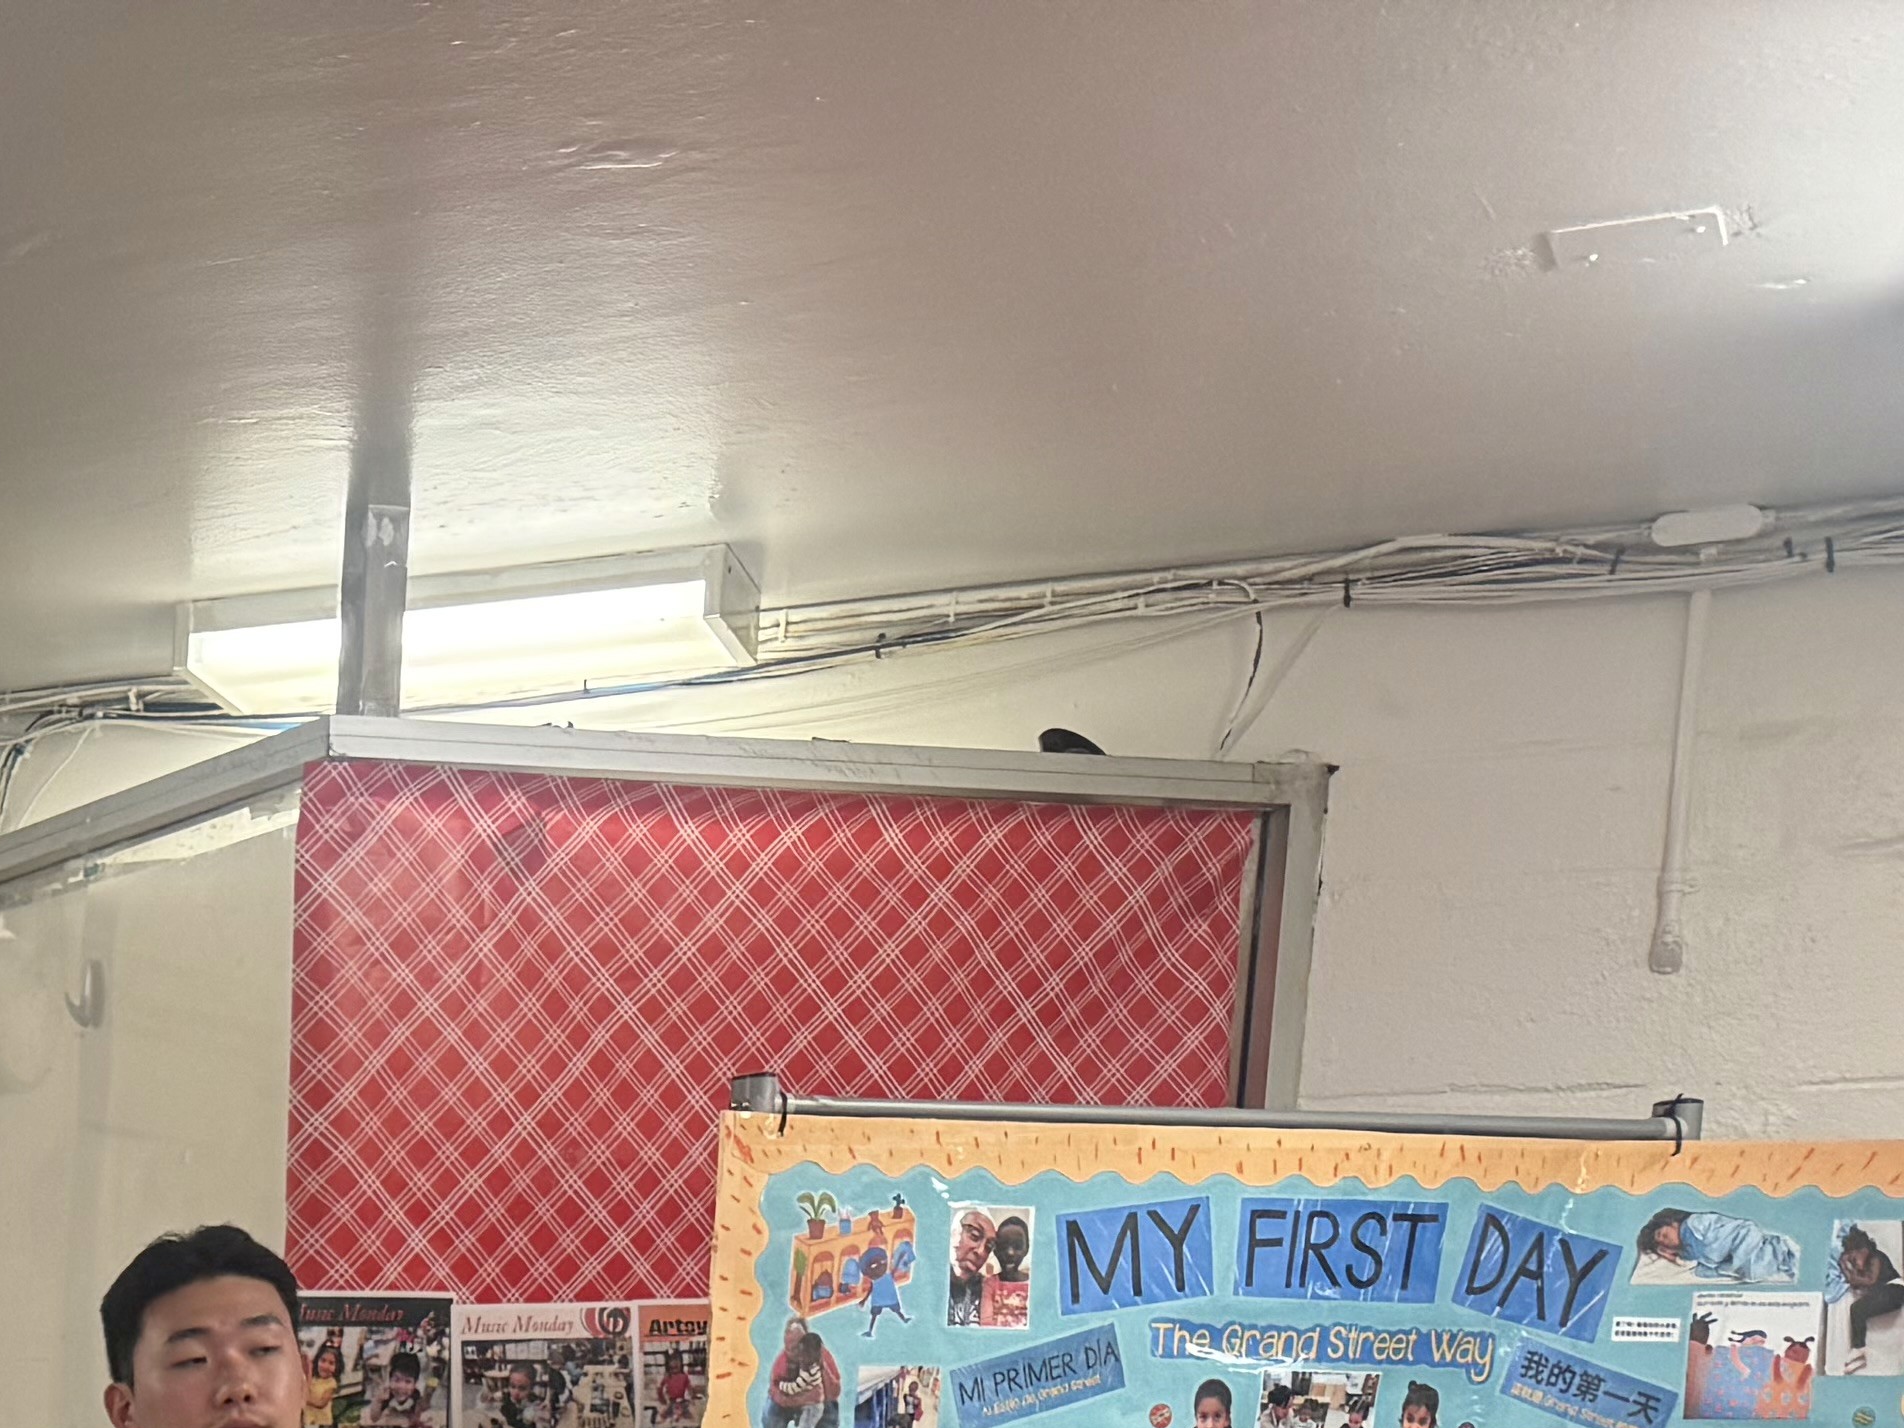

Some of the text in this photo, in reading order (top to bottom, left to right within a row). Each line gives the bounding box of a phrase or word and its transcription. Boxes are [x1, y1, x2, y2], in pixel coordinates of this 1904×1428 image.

[1065, 1203, 1610, 1329] MY FIRST DAY
[341, 1301, 405, 1324] Monday
[461, 1314, 576, 1338] Music Monday
[958, 1376, 986, 1406] MI
[993, 1351, 1078, 1398] PRIMER
[1151, 1322, 1494, 1381] The Grand Street Way
[1519, 1349, 1664, 1427] 我的第一天
